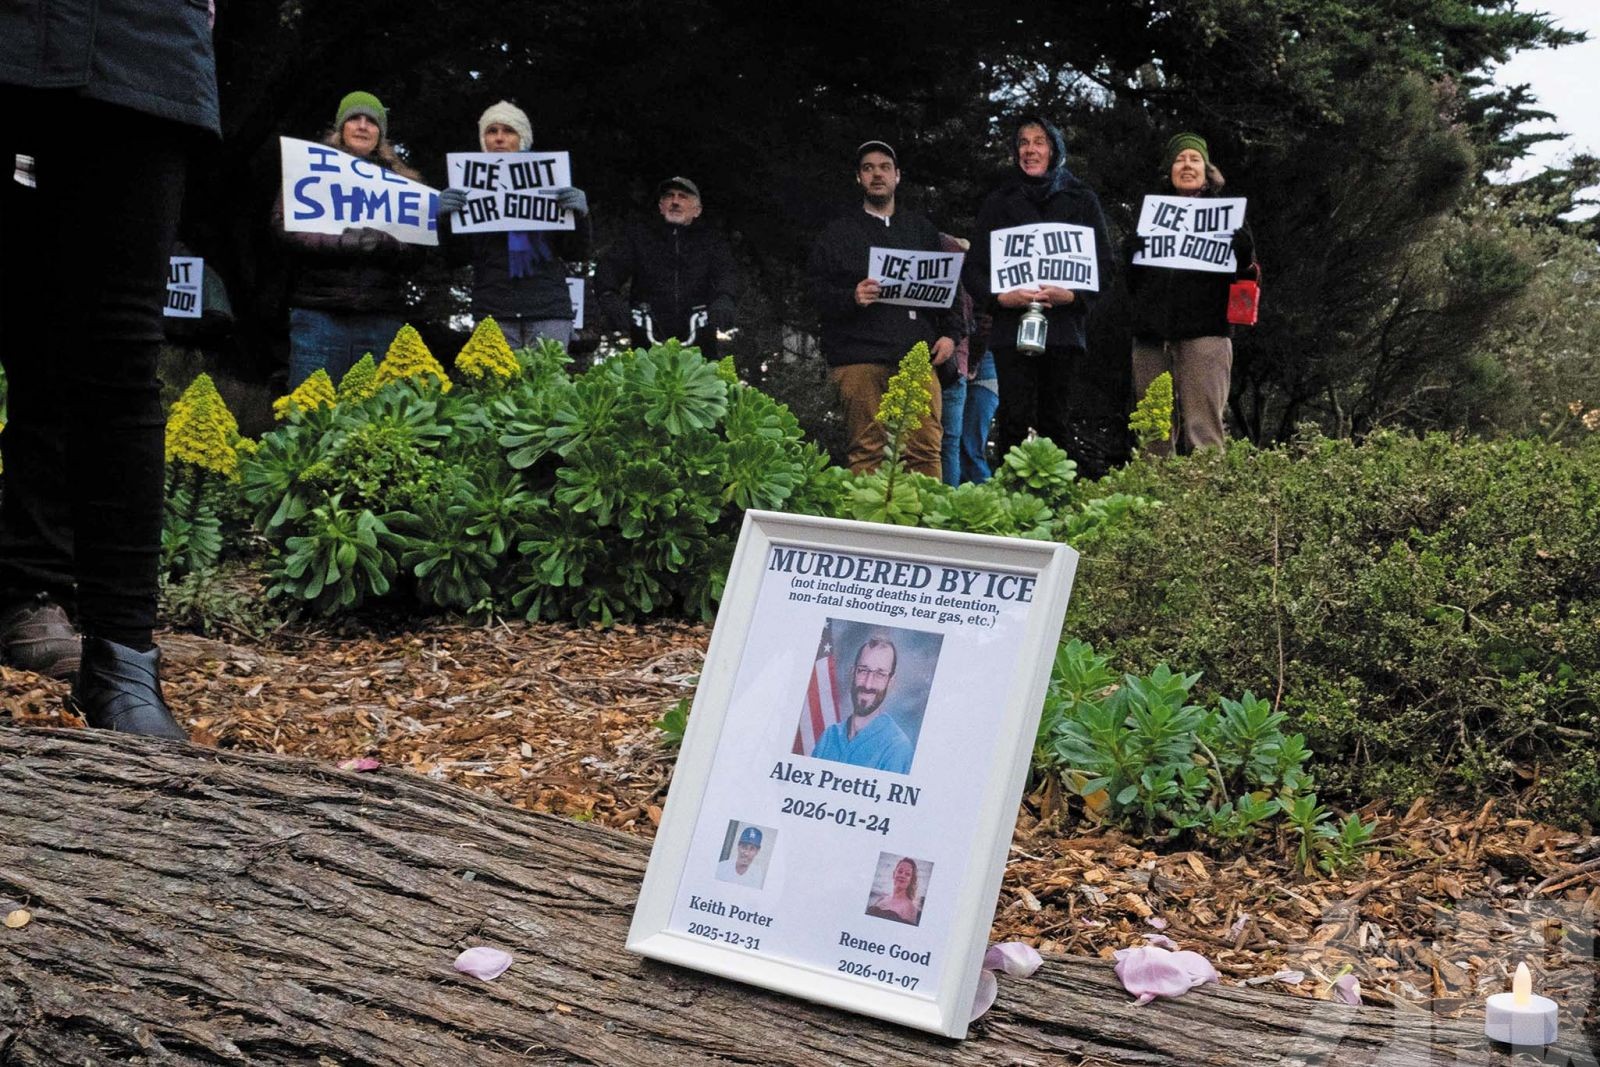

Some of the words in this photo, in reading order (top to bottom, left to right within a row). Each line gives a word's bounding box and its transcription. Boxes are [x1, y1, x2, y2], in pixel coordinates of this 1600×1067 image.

[463, 160, 500, 191] ICE
[509, 159, 556, 190] OUT
[459, 196, 500, 226] FOR
[504, 193, 566, 224] GOOD!
[1152, 202, 1188, 232] ICE
[1194, 205, 1234, 233] OUT
[1004, 233, 1035, 257] ICE
[1043, 231, 1083, 256] OUT
[1140, 235, 1176, 259] FOR
[1179, 234, 1232, 267] GOOD!
[169, 263, 192, 283] UT
[881, 254, 911, 281] ICE
[917, 257, 953, 280] OUT
[997, 261, 1034, 288] FOR
[1038, 258, 1091, 285] GOOD!
[166, 290, 196, 313] OD!
[878, 284, 902, 299] OR
[904, 282, 951, 304] GOOD!
[768, 548, 932, 590] MURDERED
[937, 568, 981, 595] BY
[984, 574, 1037, 603] ICE
[788, 589, 843, 607] non-fatal
[845, 598, 908, 618] shootings,
[911, 607, 936, 620] tear
[938, 612, 964, 625] gas,
[967, 614, 996, 628] etc.)
[790, 576, 815, 590] (not
[816, 579, 874, 600] including
[876, 587, 917, 603] deaths
[919, 593, 932, 605] in
[934, 594, 1000, 615] detention,
[769, 761, 815, 786] Alex
[817, 770, 881, 803] Pretti,
[887, 783, 921, 806] RN
[781, 797, 890, 836] 2026-01-24
[689, 895, 726, 916] Keith
[728, 905, 773, 927] Porter
[688, 922, 760, 950] 2025-12-31
[838, 931, 885, 955] Renee
[889, 944, 931, 966] Good
[838, 959, 920, 991] 2026-01-07
